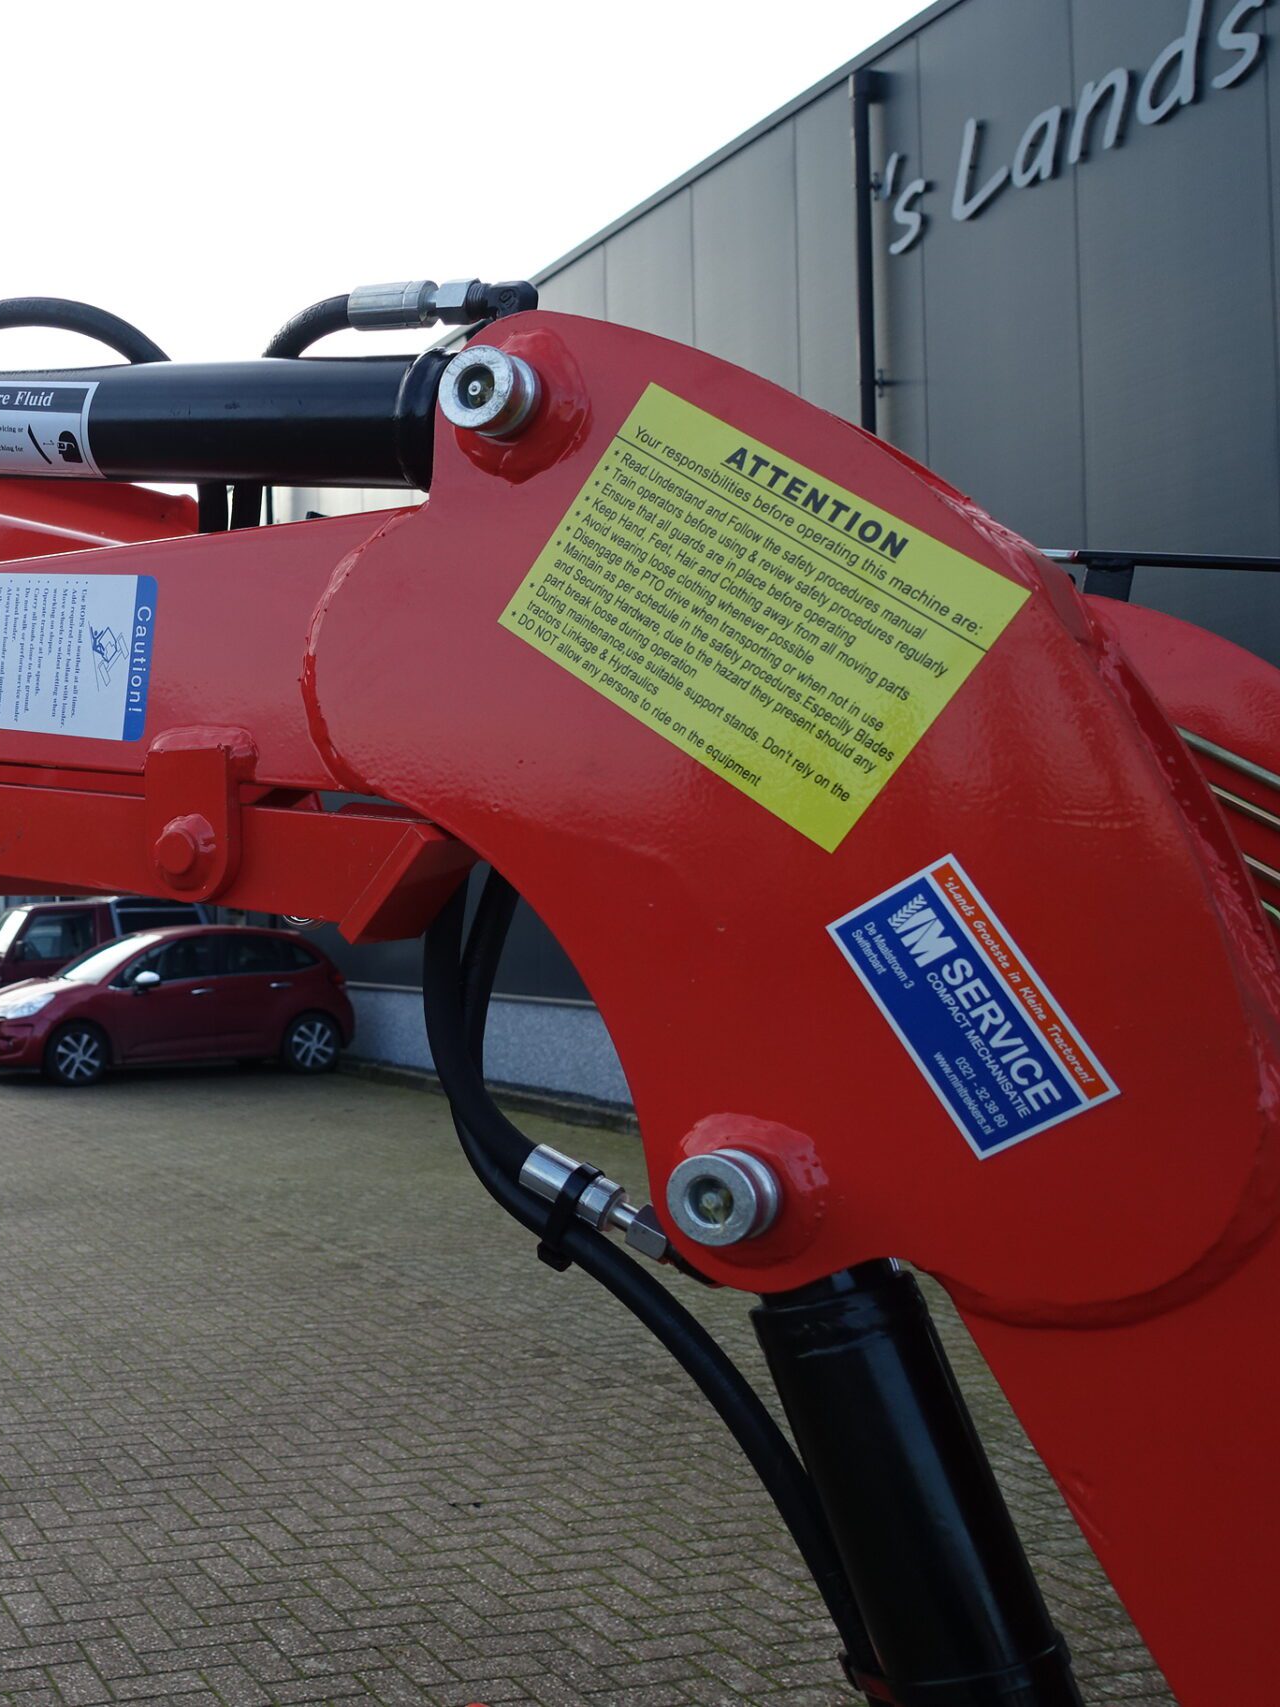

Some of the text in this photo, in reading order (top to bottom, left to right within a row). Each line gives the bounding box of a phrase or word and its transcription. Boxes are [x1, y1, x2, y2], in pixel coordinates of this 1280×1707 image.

[886, 0, 1266, 255] 's Lands
[13, 390, 54, 407] Fluid
[600, 481, 857, 648] Ensure that all guards are in place before operating
[611, 466, 949, 679] Train operators before using & review safety procedures regularly
[634, 424, 983, 636] Your responsibilities before operating this machine are:
[704, 504, 729, 523] and
[725, 514, 764, 543] Follow
[761, 536, 782, 555] the
[780, 549, 817, 578] safety
[813, 570, 881, 614] procedures
[879, 608, 928, 640] manual
[723, 446, 909, 559] ATTENTION
[127, 605, 152, 712] Caution!
[525, 599, 659, 696] tractors Linkage & Hydraulics
[542, 572, 698, 678] part break loose during operation
[562, 540, 604, 575] Maintain
[602, 569, 617, 584] as
[613, 578, 636, 594] per
[633, 589, 680, 624] schedule
[677, 615, 691, 631] in
[690, 623, 709, 642] the
[707, 637, 743, 665] safety
[852, 727, 895, 762] Blades
[571, 526, 884, 732] Disengage the PTO drive when transporting or when not in use
[580, 512, 814, 665] Avoid wearing loose clothing whenever possible
[590, 496, 910, 701] Keep Hand, Feet, Hair and Clothing away from all moving parts
[516, 612, 762, 787] DO NOT allow any persons to ride on the equipment
[534, 584, 567, 615] During
[643, 660, 684, 691] suitable
[682, 686, 725, 718] support
[722, 712, 759, 743] stands.
[760, 735, 793, 764] Don't
[790, 758, 815, 779] rely
[813, 773, 831, 789] on
[829, 781, 850, 802] the
[553, 558, 877, 774] and Securing Hardware, due to the hazard they present should any
[850, 928, 887, 975] Swifterbant
[863, 920, 877, 936] De
[902, 979, 915, 989] 3
[972, 919, 1010, 969] Grootste
[1006, 970, 1021, 983] in
[1018, 985, 1047, 1021] Kleine
[1046, 1023, 1095, 1083] Tractoren!
[925, 971, 1031, 1118] COMPACT MECHANISATIE
[940, 957, 1062, 1111] SERVICE
[954, 1055, 976, 1080] 0321
[974, 1085, 990, 1102] 32
[983, 1099, 999, 1114] 38
